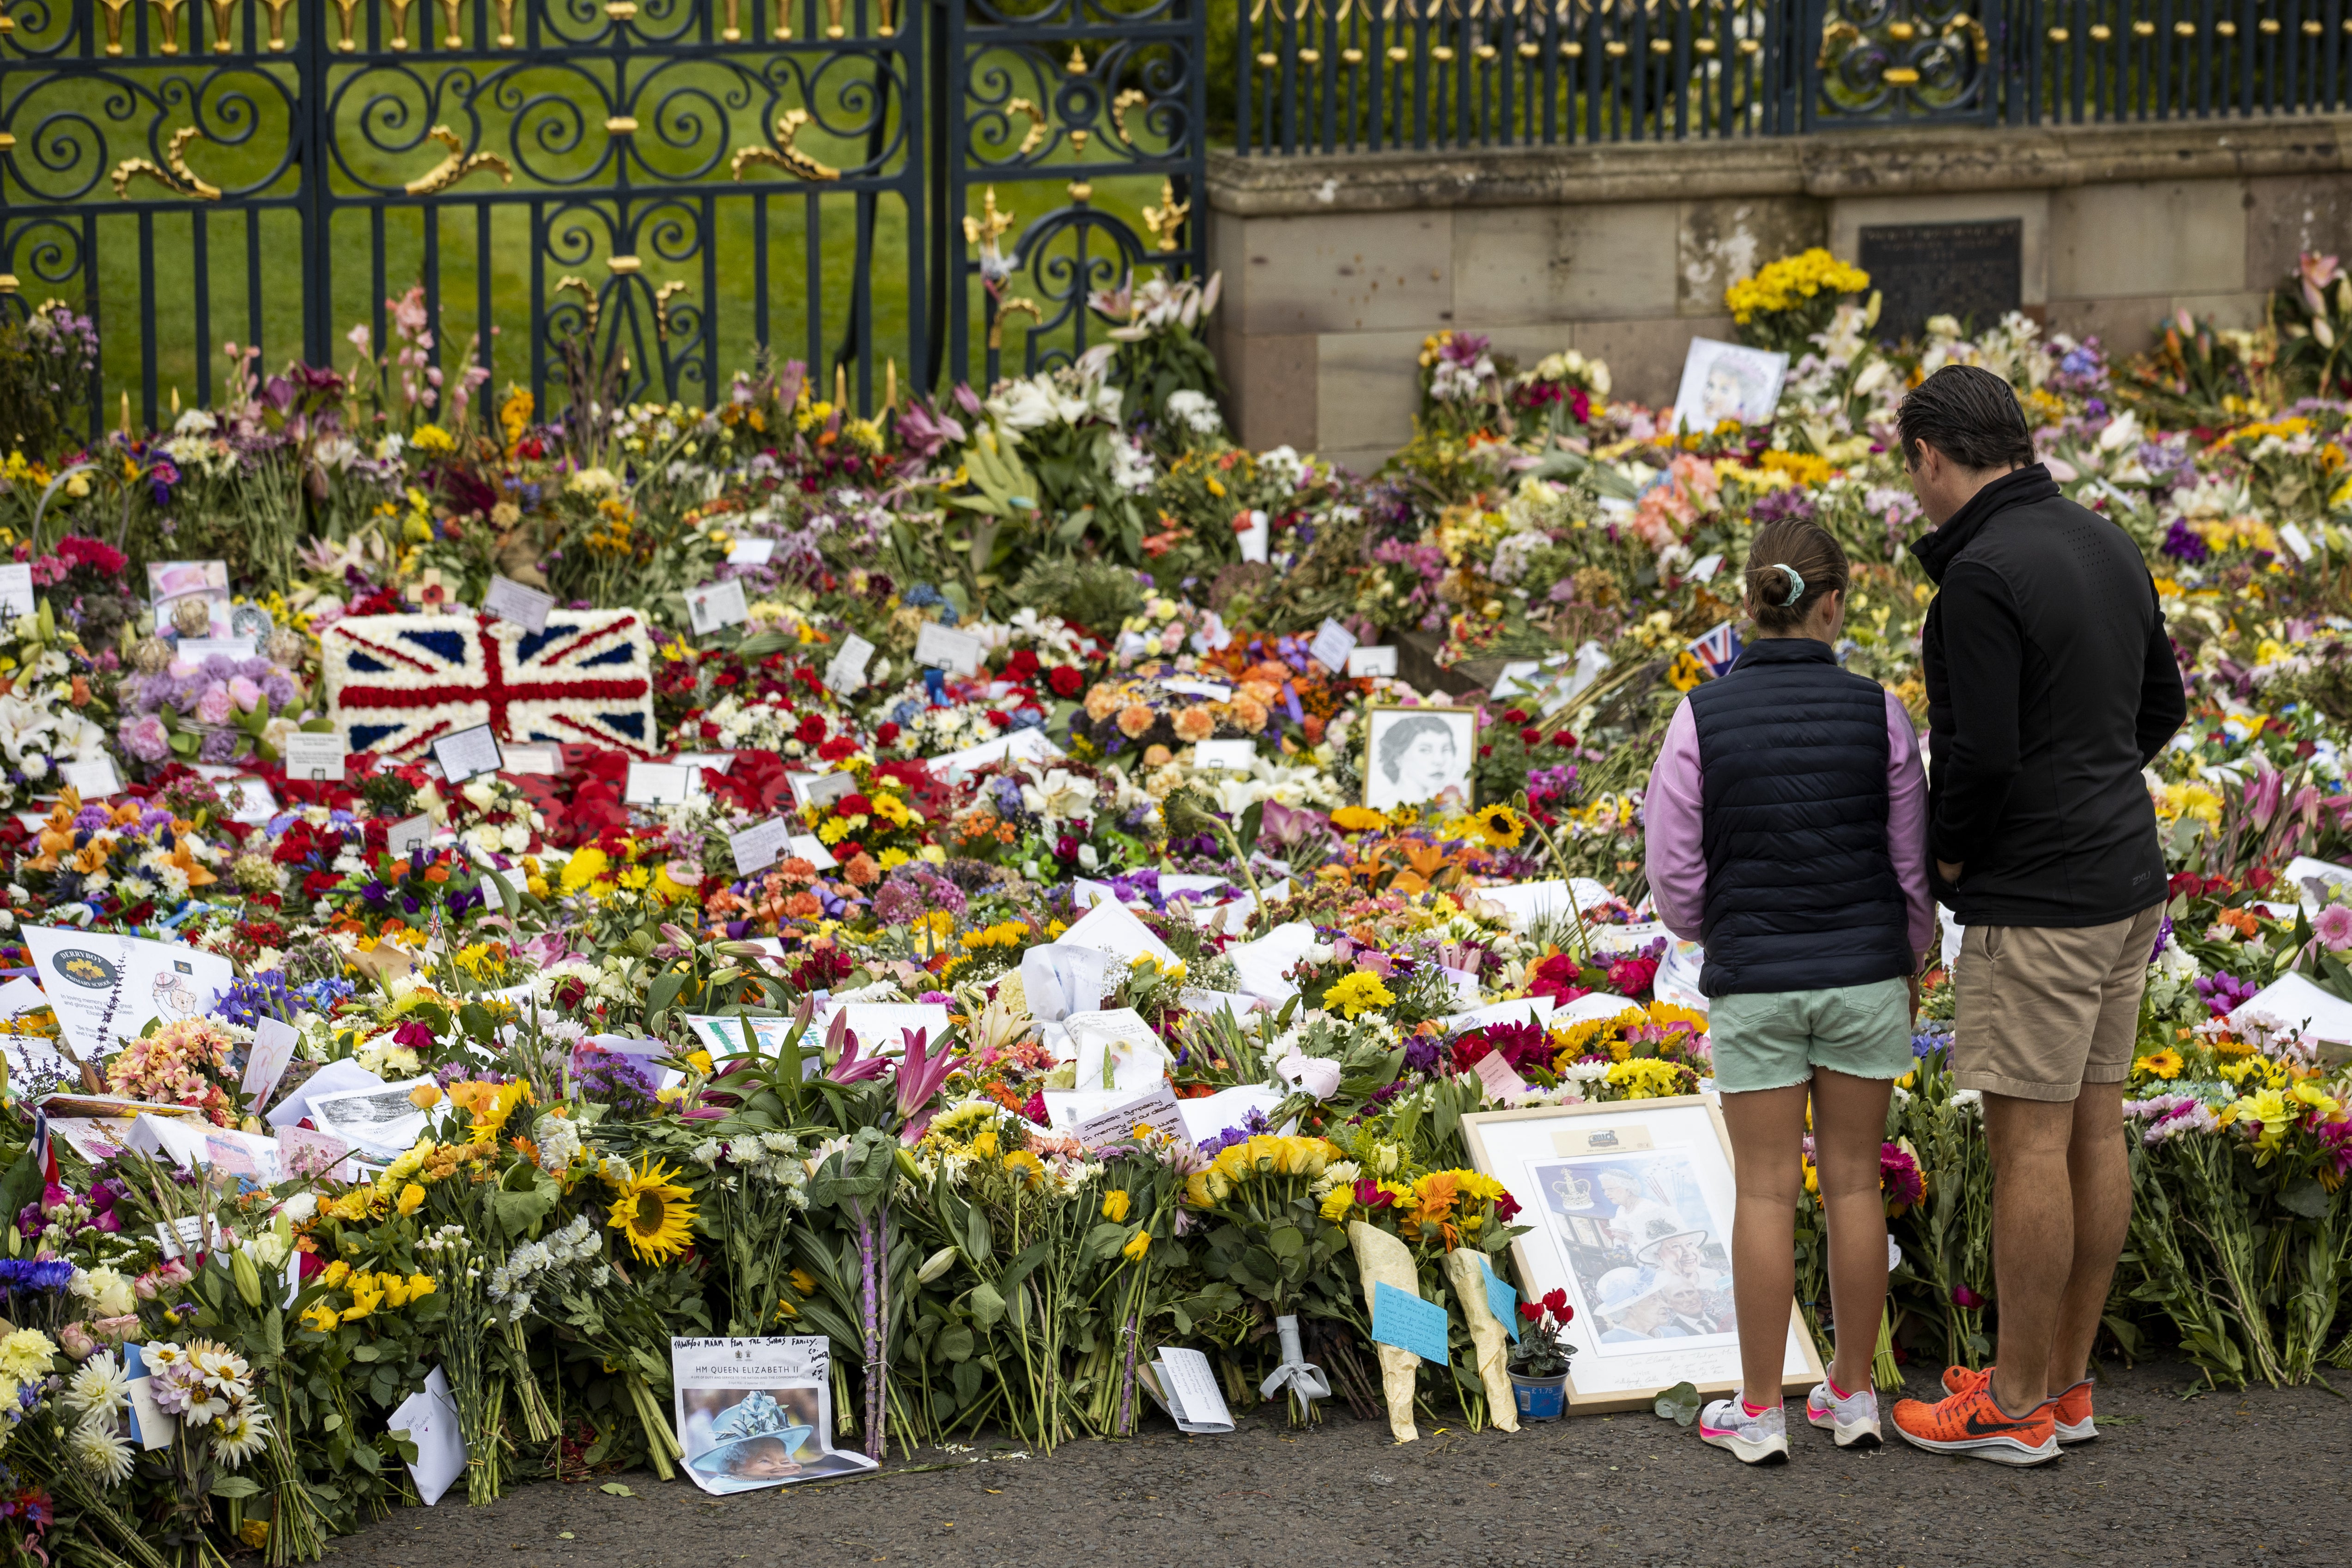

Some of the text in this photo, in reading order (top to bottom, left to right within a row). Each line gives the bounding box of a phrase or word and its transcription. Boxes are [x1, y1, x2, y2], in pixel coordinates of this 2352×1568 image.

[2133, 870, 2151, 887] 2XU
[60, 951, 103, 963] DERRYBOY
[66, 974, 91, 987] PRIMARY
[67, 995, 82, 1003] loving
[1084, 1114, 1121, 1131] Deepest
[1094, 1123, 1126, 1137] memory
[1151, 1102, 1177, 1115] dearest
[1157, 1117, 1180, 1128] Nurse
[1381, 1289, 1396, 1298] Thank
[1381, 1307, 1398, 1315] Thank
[1405, 1306, 1420, 1315] service
[1381, 1320, 1397, 1331] strong
[1398, 1325, 1415, 1334] women
[1393, 1331, 1406, 1339] bless
[1408, 1334, 1423, 1343] Queen
[711, 1366, 739, 1374] QUEEN
[1183, 1378, 1192, 1395] everything
